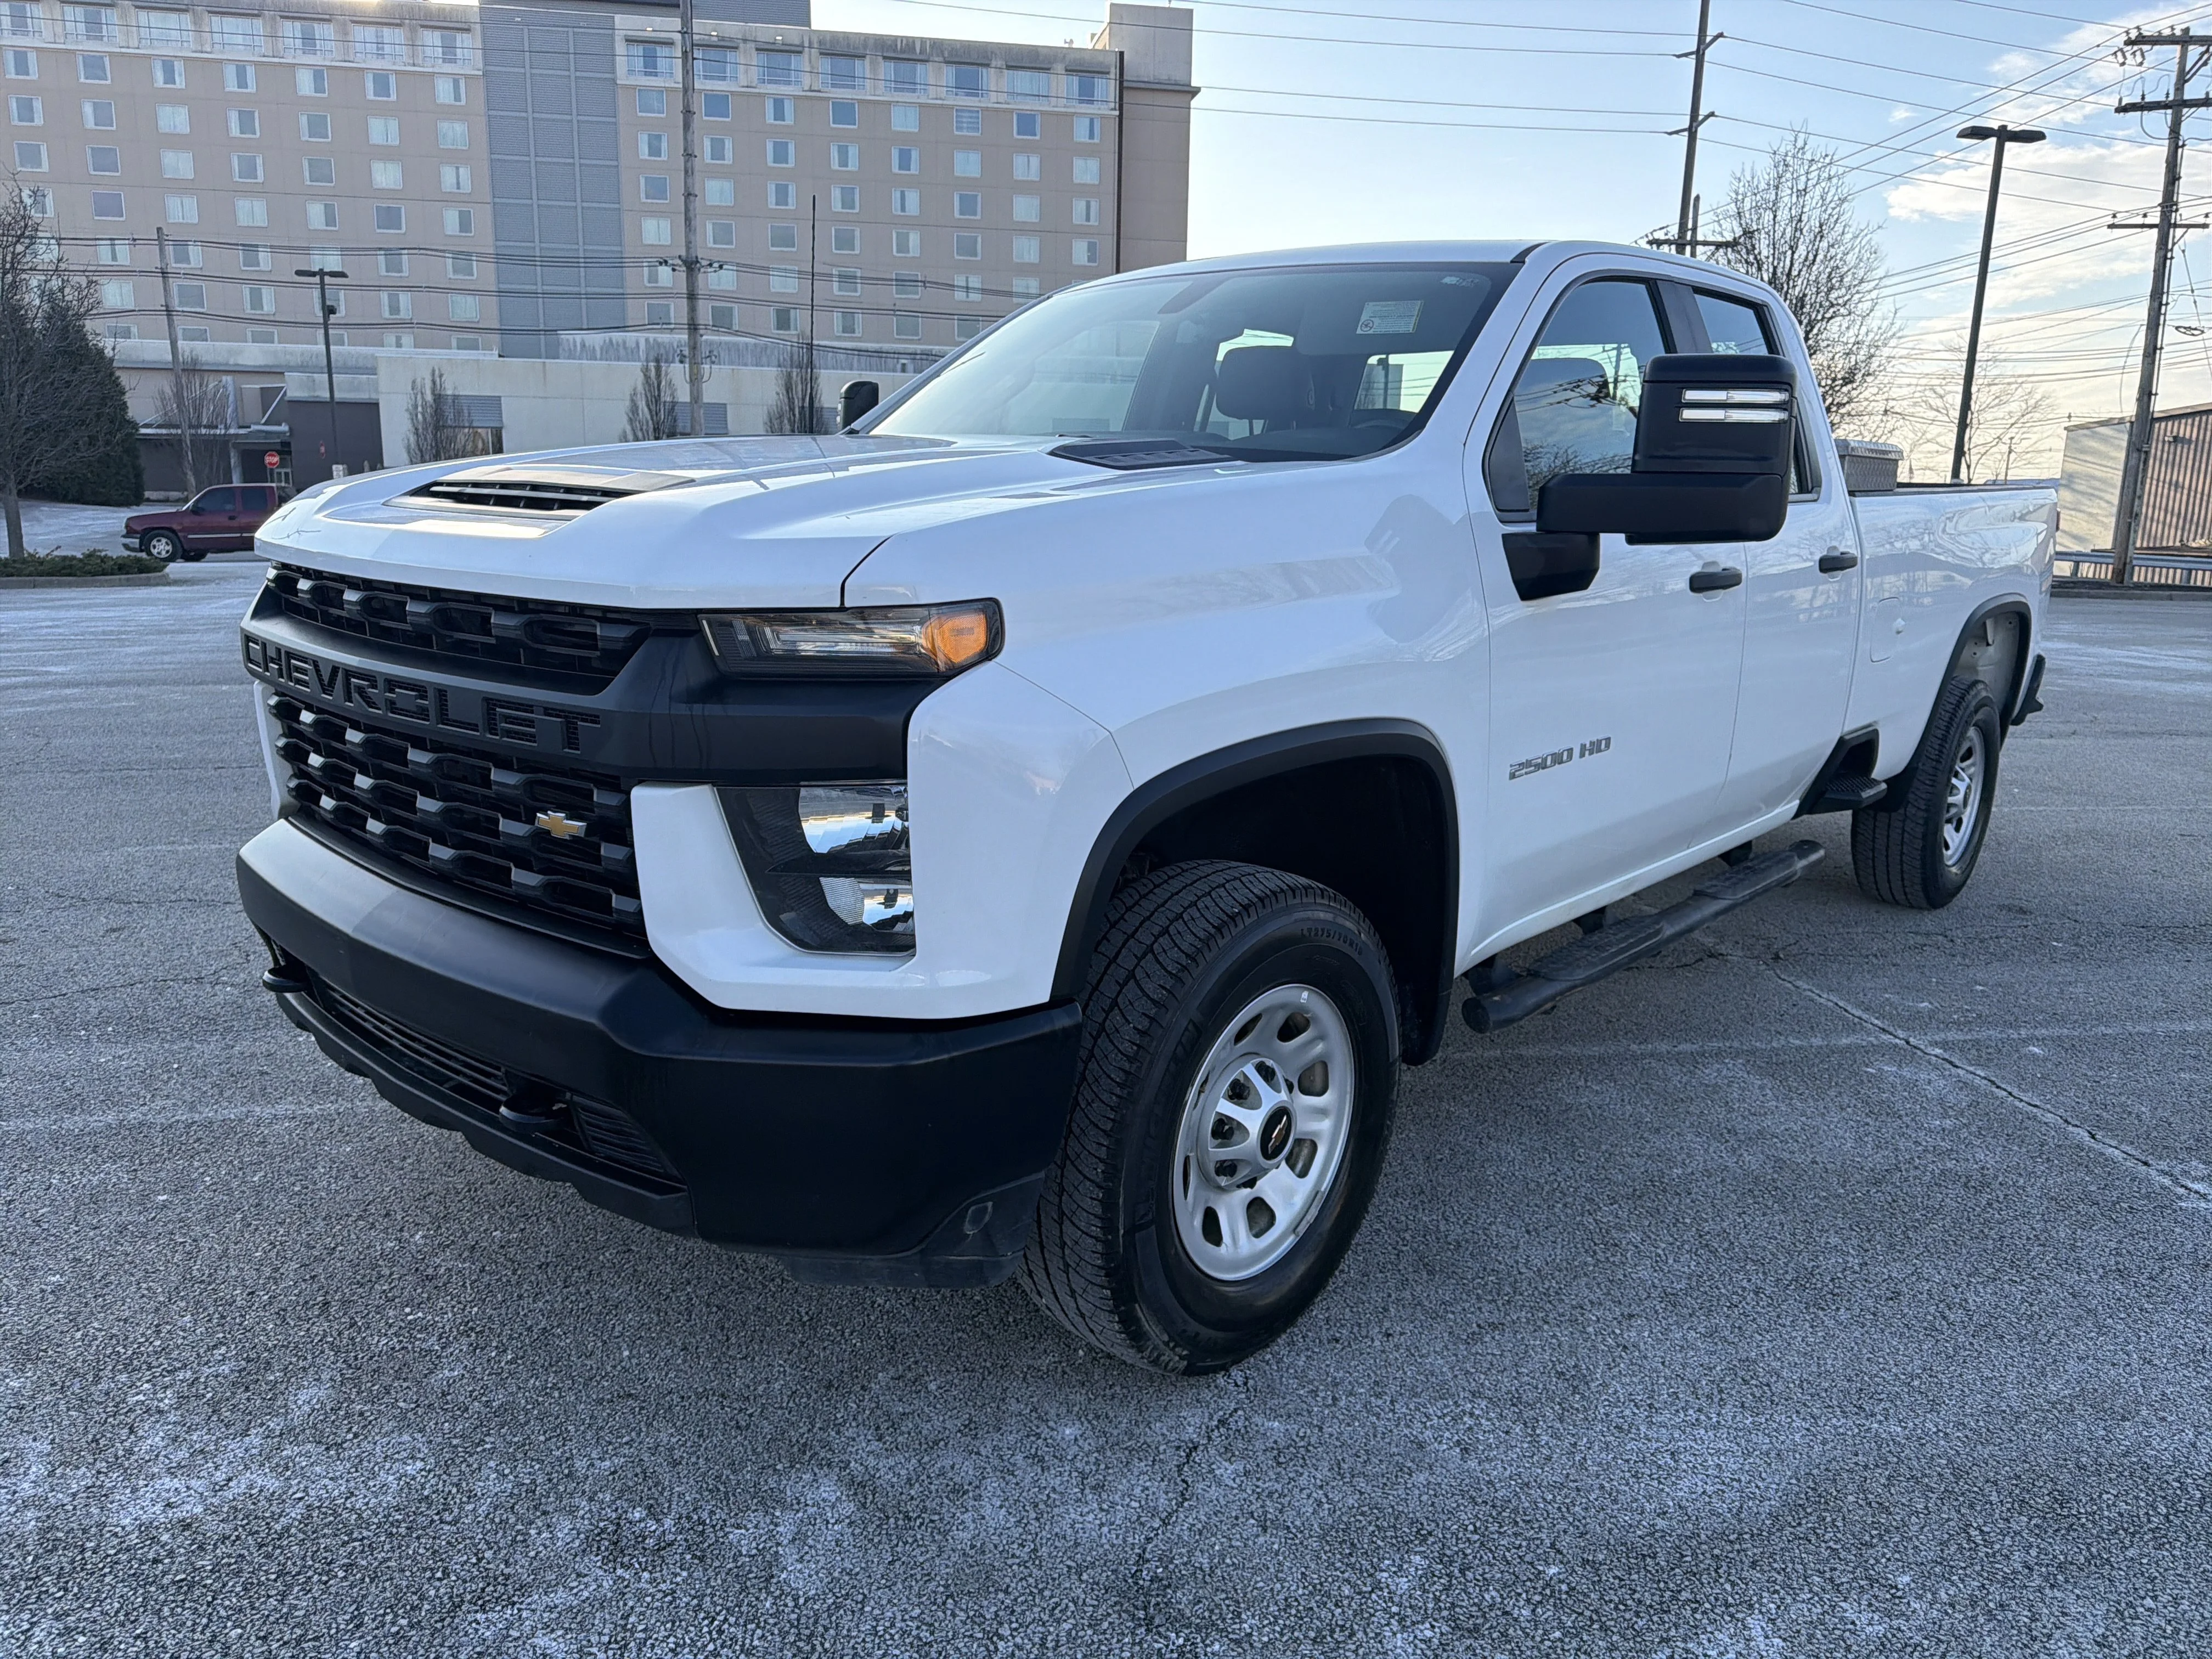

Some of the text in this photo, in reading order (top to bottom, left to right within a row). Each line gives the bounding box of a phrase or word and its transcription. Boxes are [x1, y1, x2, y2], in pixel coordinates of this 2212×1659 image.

[244, 634, 601, 754] CHEVROLET
[1509, 735, 1611, 780] 2500 HD
